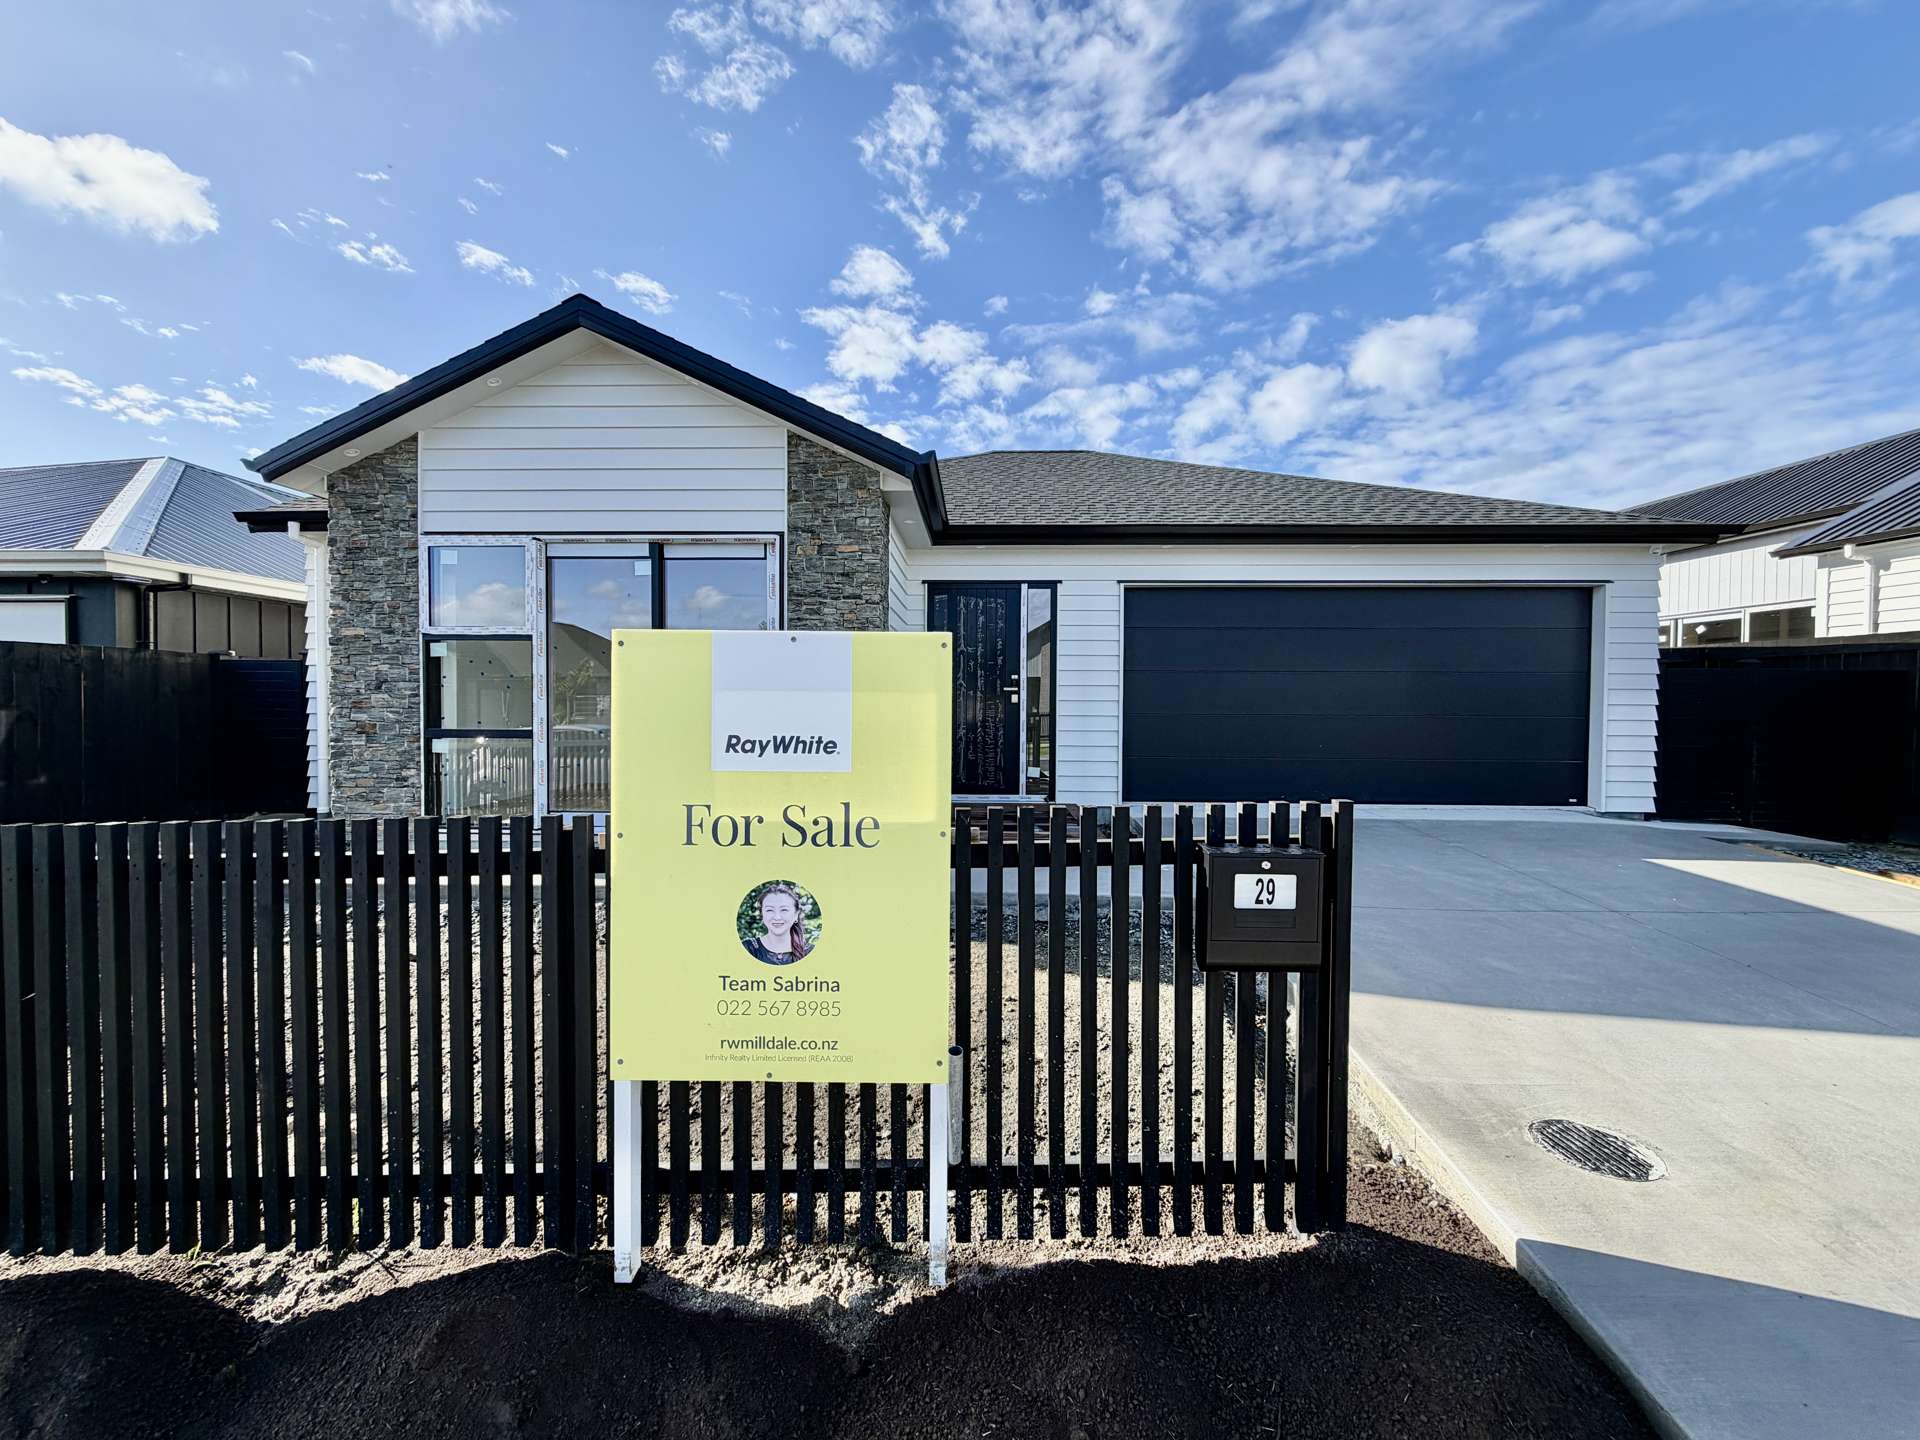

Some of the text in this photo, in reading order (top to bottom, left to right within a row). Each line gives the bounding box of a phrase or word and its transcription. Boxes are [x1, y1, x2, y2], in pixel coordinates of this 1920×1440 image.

[682, 802, 880, 848] For Sale
[1254, 878, 1276, 905] 29
[718, 975, 840, 993] Team Sabrina
[716, 999, 841, 1017] 022 567 8985
[720, 1036, 839, 1051] rwmilldale.co.nz
[729, 1054, 751, 1062] Realty
[752, 1054, 776, 1062] Limited
